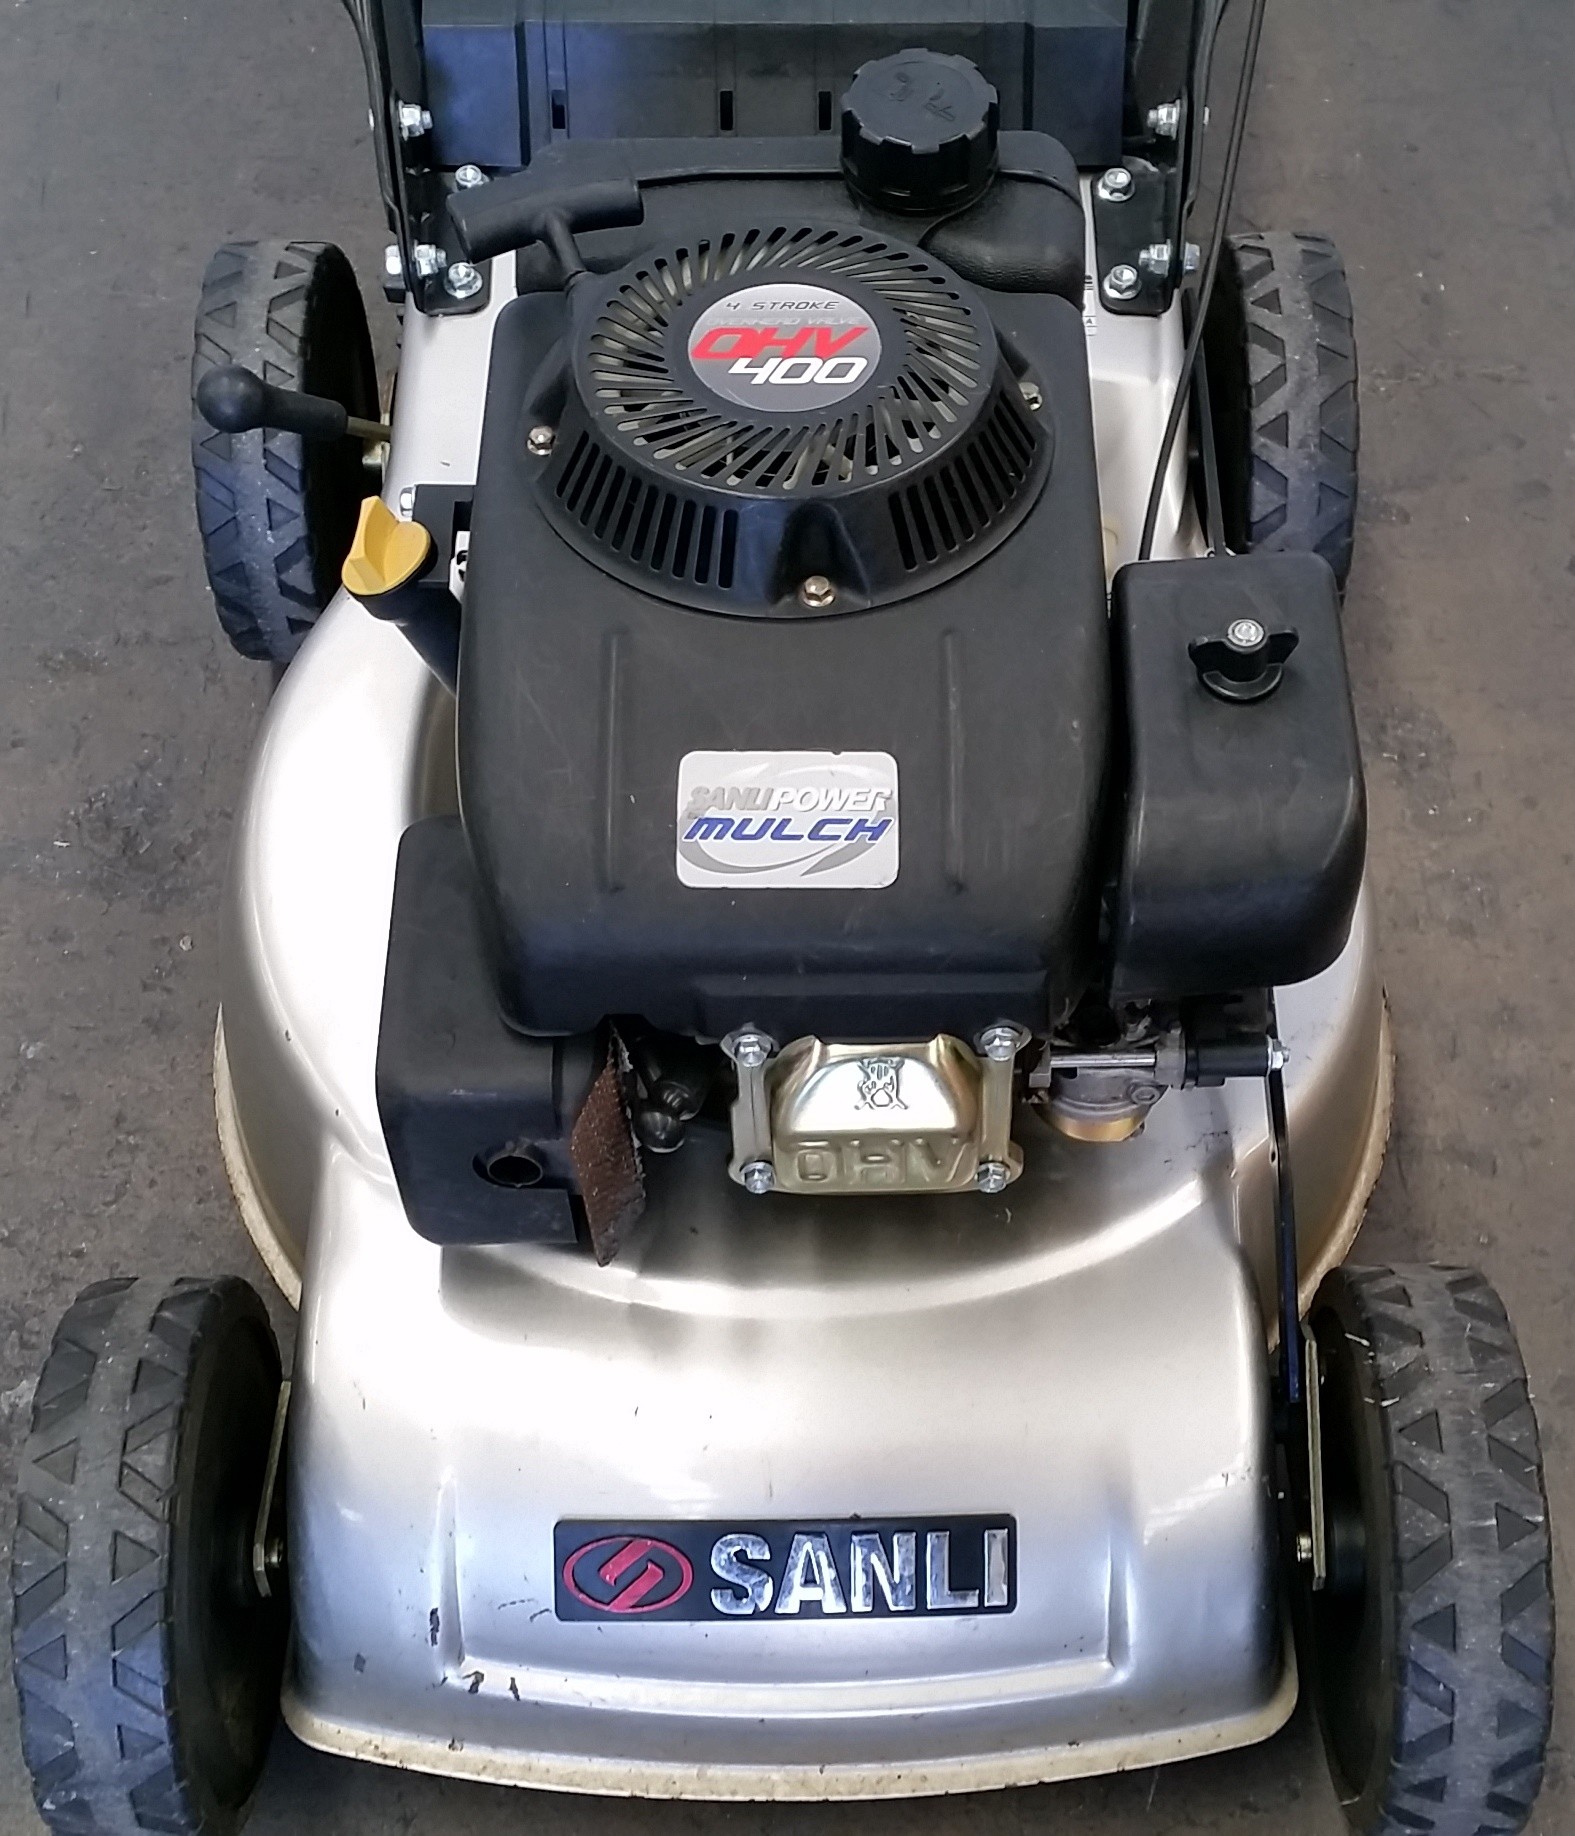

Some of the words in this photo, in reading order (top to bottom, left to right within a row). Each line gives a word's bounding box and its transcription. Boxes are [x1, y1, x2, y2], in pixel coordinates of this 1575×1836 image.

[726, 301, 740, 310] 4
[752, 301, 839, 310] STROKE
[808, 317, 863, 325] VALVE
[691, 326, 868, 359] OHV
[728, 357, 868, 385] 400
[684, 817, 892, 841] MULCH
[796, 1138, 970, 1183] OHV
[710, 1528, 1008, 1614] SANLI
